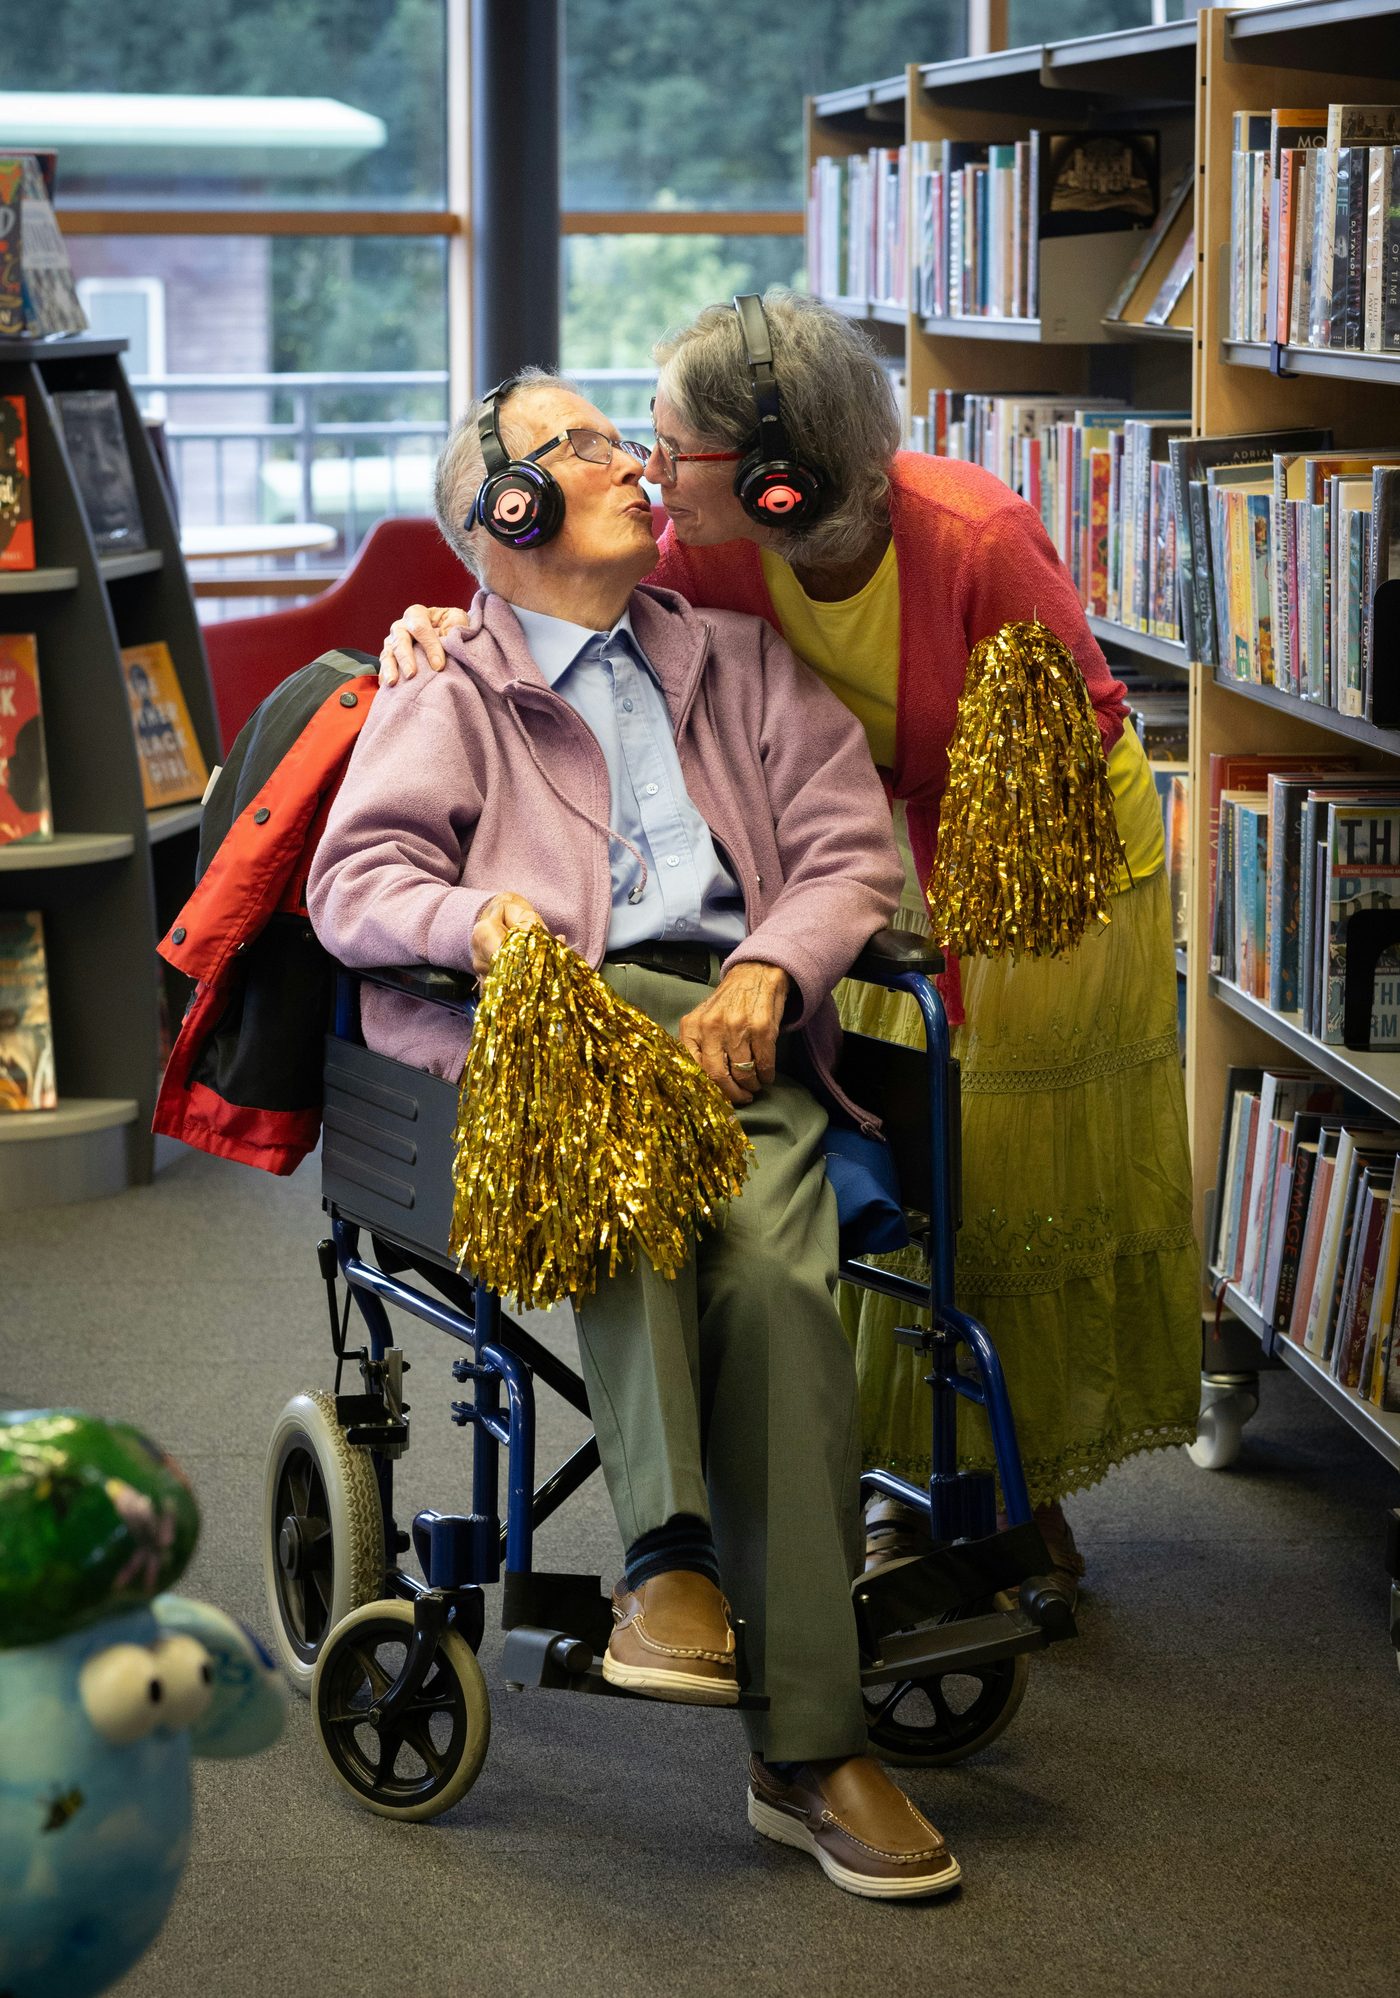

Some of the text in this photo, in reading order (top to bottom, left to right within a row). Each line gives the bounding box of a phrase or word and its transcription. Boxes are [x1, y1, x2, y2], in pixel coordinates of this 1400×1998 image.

[1297, 135, 1327, 149] MO
[1281, 154, 1290, 217] ANIMAL
[1337, 186, 1349, 217] LIE
[1389, 243, 1399, 305] OF TIME
[1232, 448, 1276, 460] ADRIAN
[1172, 449, 1184, 529] THE DOORS
[1192, 502, 1203, 547] CAGE
[1198, 579, 1208, 631] SOULS
[1372, 532, 1380, 580] Towles
[1166, 584, 1174, 611] WAR
[1340, 819, 1400, 866] TH
[1285, 1154, 1309, 1257] DAMAGE
